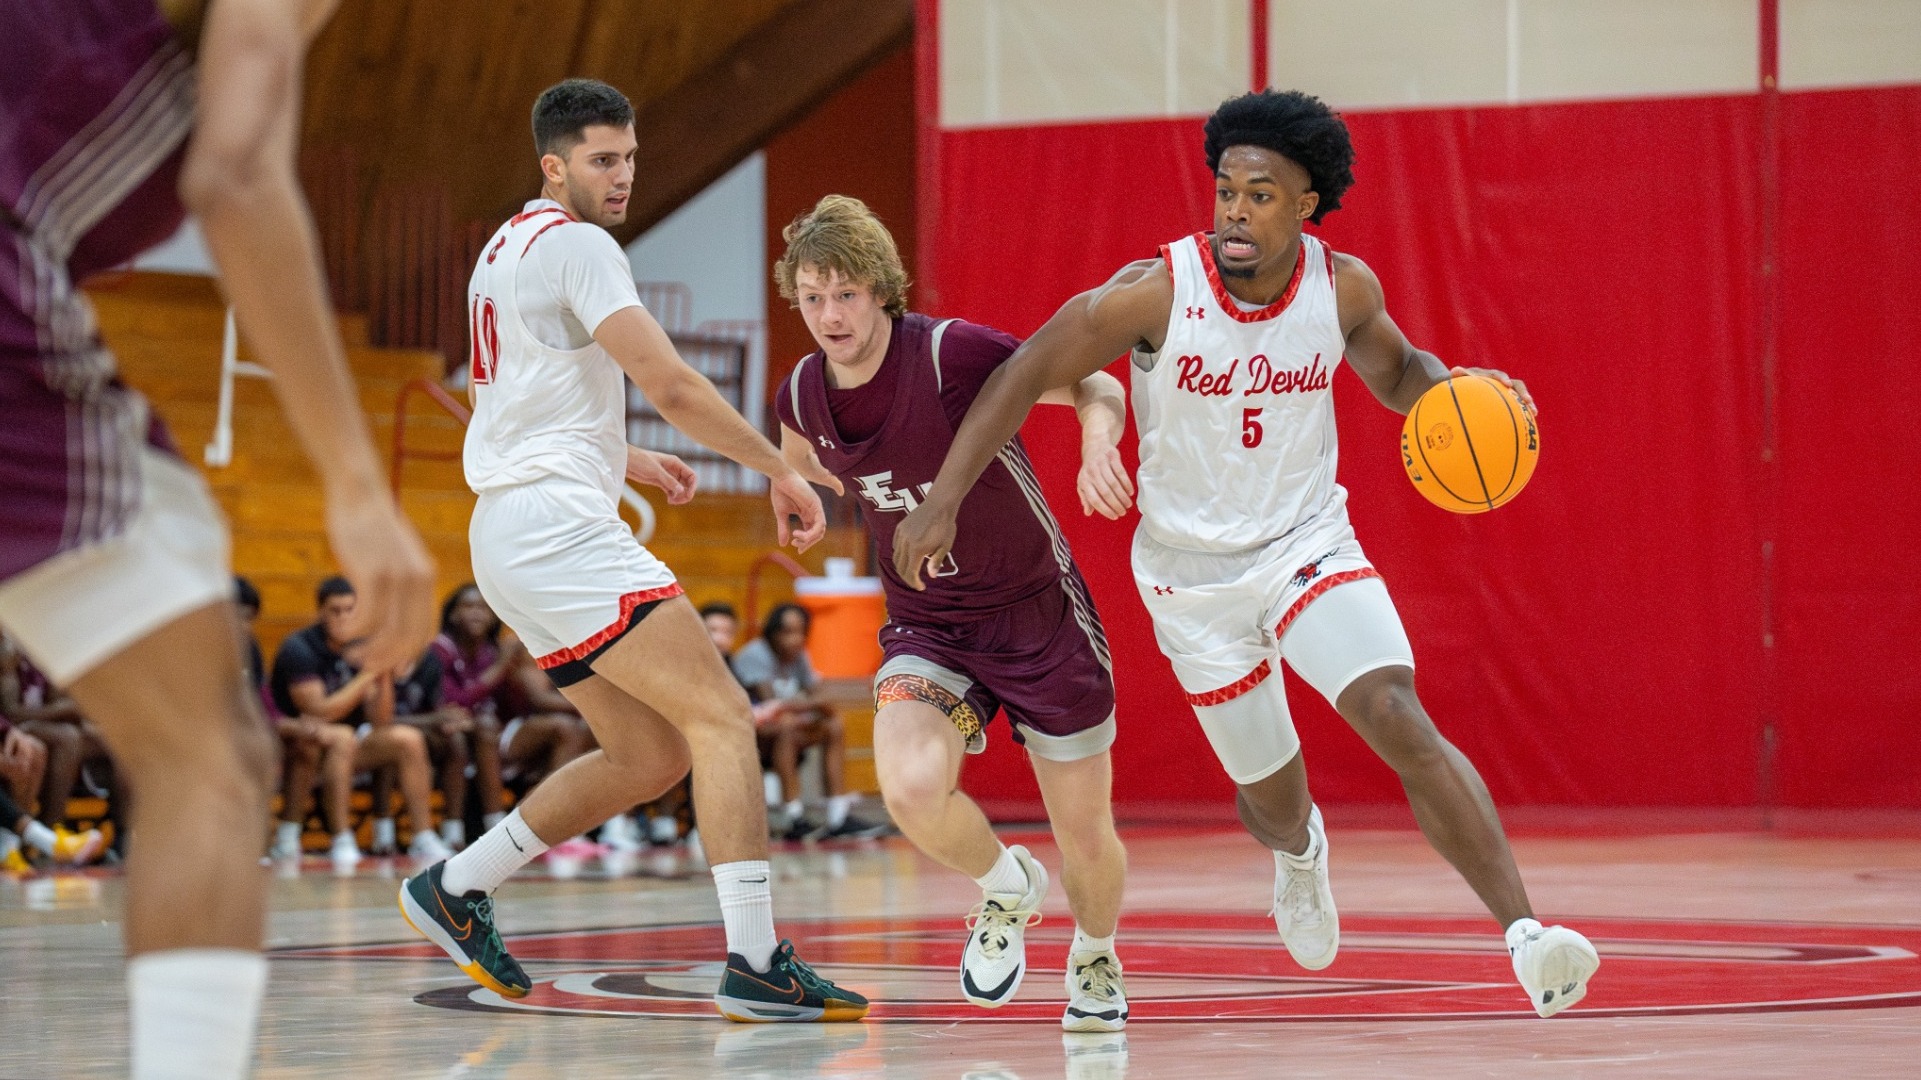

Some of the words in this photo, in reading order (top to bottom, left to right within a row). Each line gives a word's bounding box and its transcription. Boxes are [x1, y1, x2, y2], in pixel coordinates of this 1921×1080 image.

[1176, 354, 1239, 397] Red
[1243, 352, 1329, 397] Devils
[1241, 407, 1264, 449] 5
